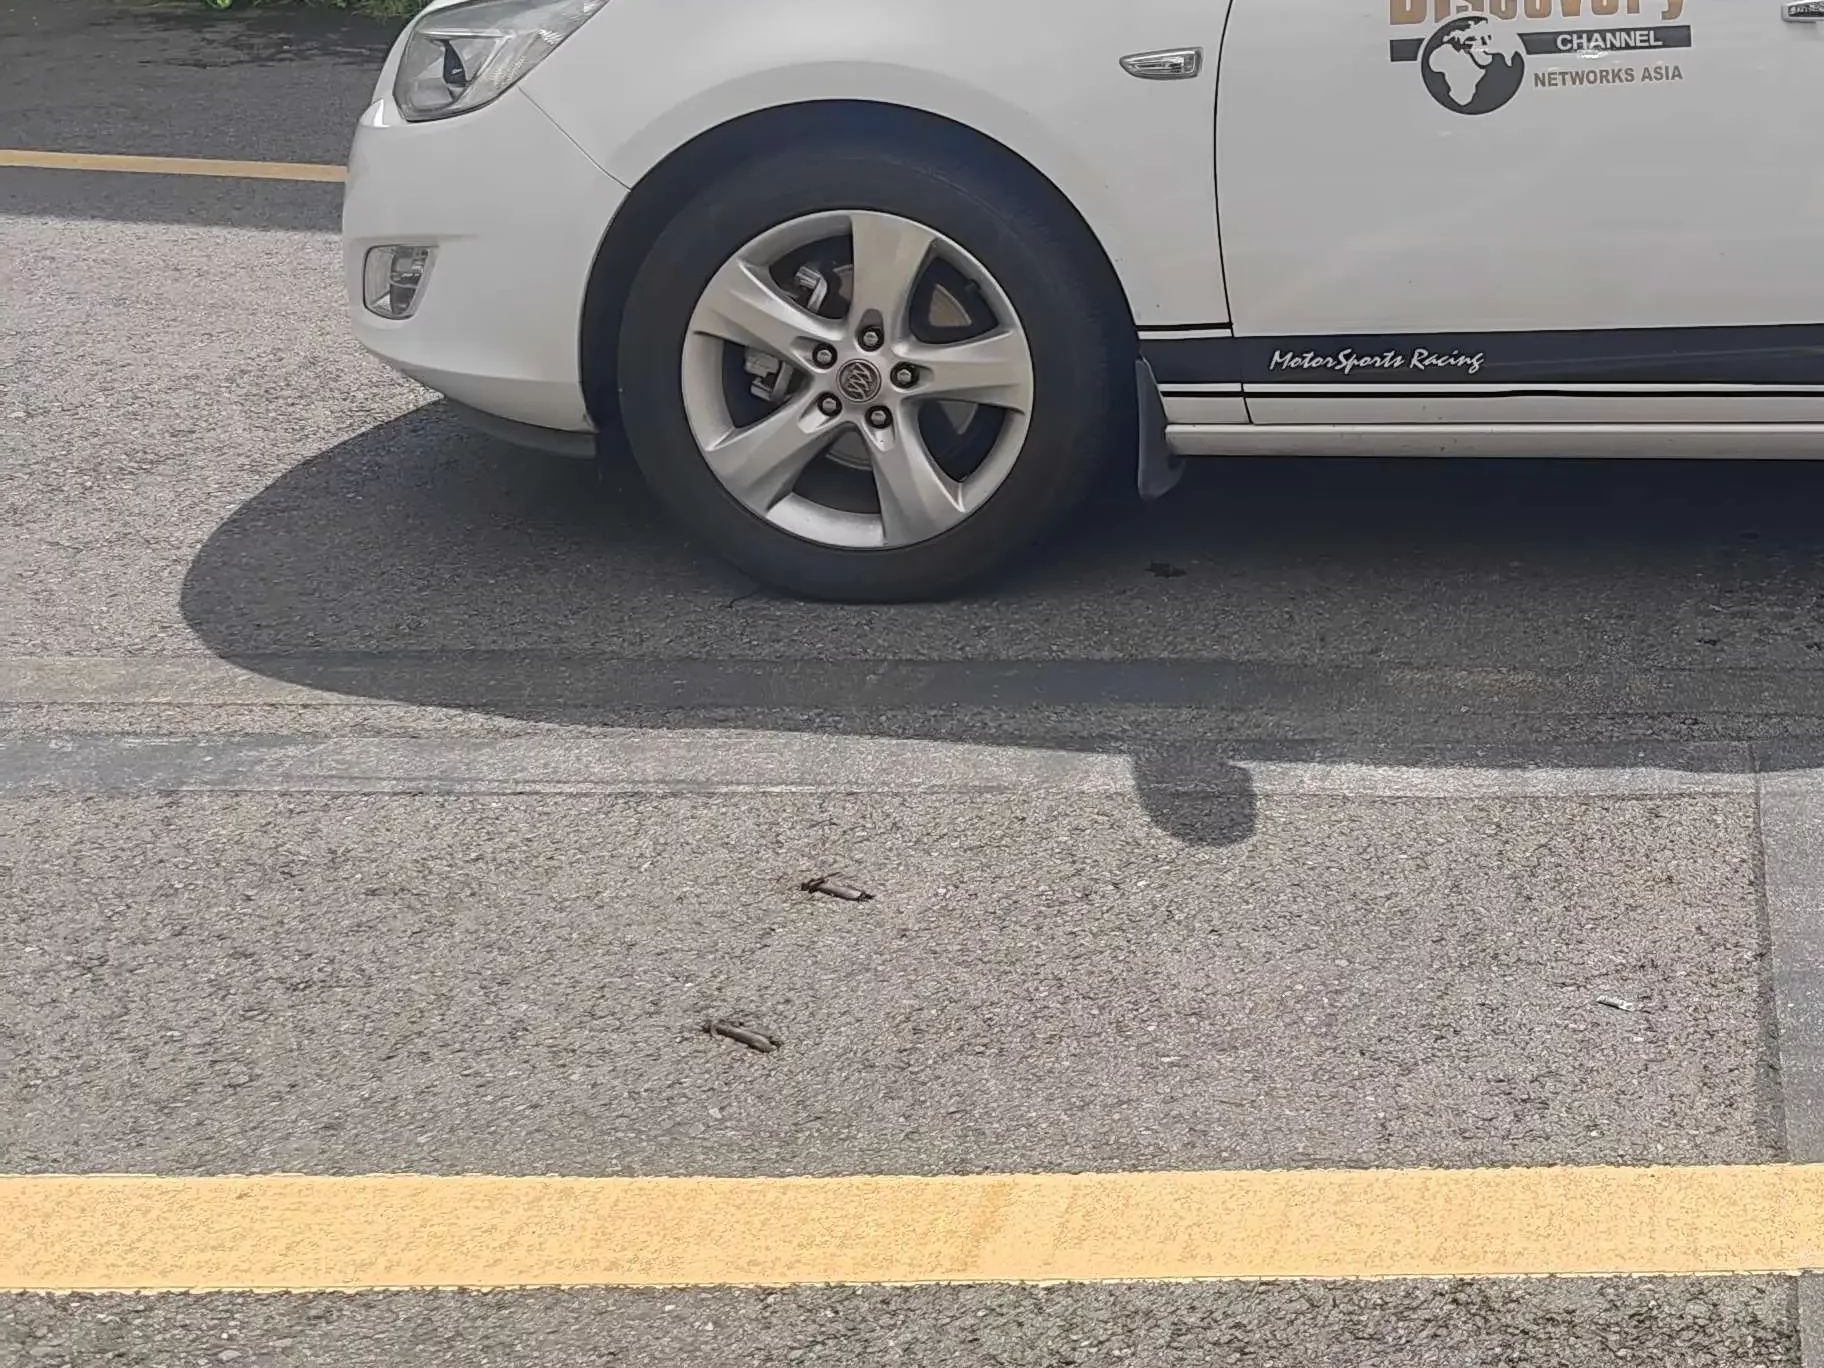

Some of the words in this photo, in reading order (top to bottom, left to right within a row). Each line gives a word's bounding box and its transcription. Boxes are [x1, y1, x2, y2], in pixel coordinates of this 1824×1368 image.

[1556, 30, 1663, 52] CHANNEL
[1533, 67, 1635, 88] NETWORKS
[1640, 64, 1684, 82] ASIA
[1269, 348, 1407, 375] MotorSports
[1409, 348, 1485, 374] Racing
